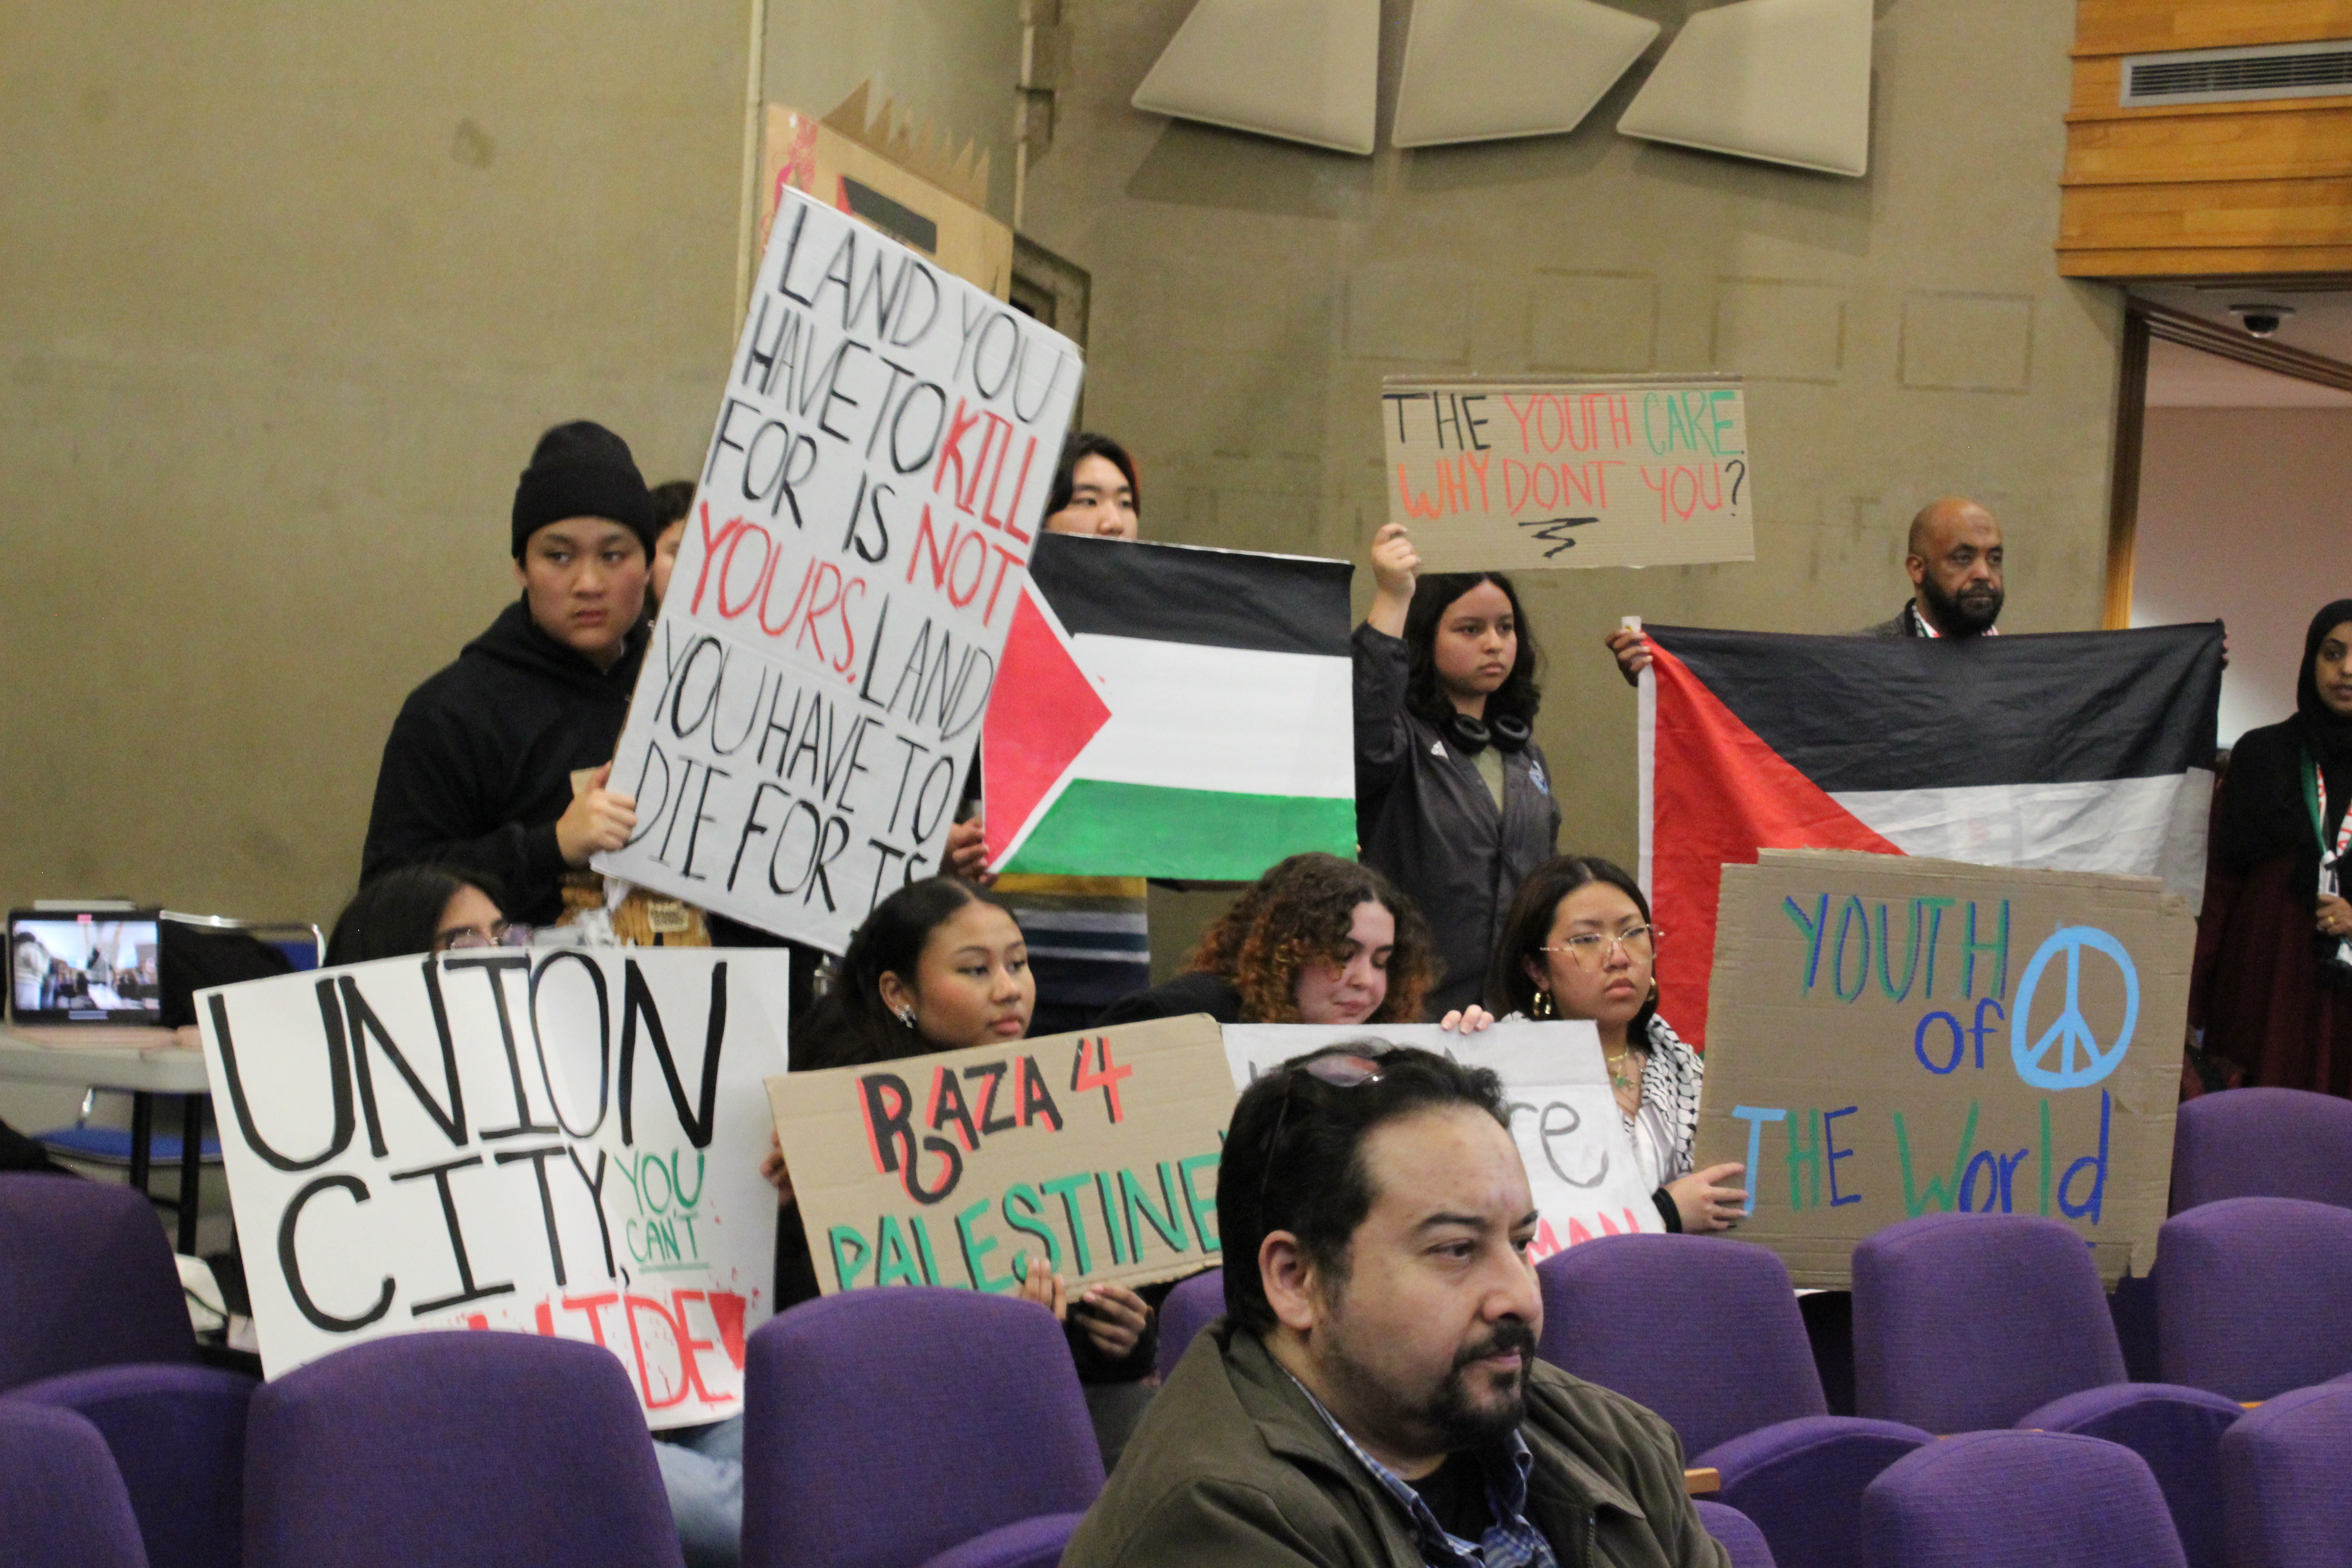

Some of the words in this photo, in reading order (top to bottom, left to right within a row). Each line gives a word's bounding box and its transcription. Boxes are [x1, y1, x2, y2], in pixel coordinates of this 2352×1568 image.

[779, 204, 939, 348] LAND
[952, 290, 1064, 424] YOU
[742, 294, 872, 444] HAVE
[865, 355, 946, 474] TO
[933, 396, 1037, 545] KILL
[1382, 391, 1491, 451] THE
[1503, 392, 1632, 453] YOUTH
[1398, 451, 1490, 519] WHY
[1503, 458, 1626, 515] DONT
[1641, 459, 1745, 523] YOU?
[705, 396, 818, 529] FOR
[841, 470, 896, 564] IS
[906, 502, 1026, 627] NOT
[691, 498, 866, 683] YOURS.
[860, 592, 994, 742] LAND
[654, 617, 767, 755] YOU
[756, 672, 884, 813] HAVE
[888, 734, 954, 844] TO
[622, 738, 731, 882] DIE
[726, 780, 850, 913] FOR
[1782, 893, 2010, 1003] YOUTH
[207, 949, 728, 1172] UNION
[856, 1055, 1063, 1205] RAZA
[1071, 1036, 1133, 1123] 4
[614, 1148, 705, 1216] YOU
[1732, 1104, 1862, 1218] THE
